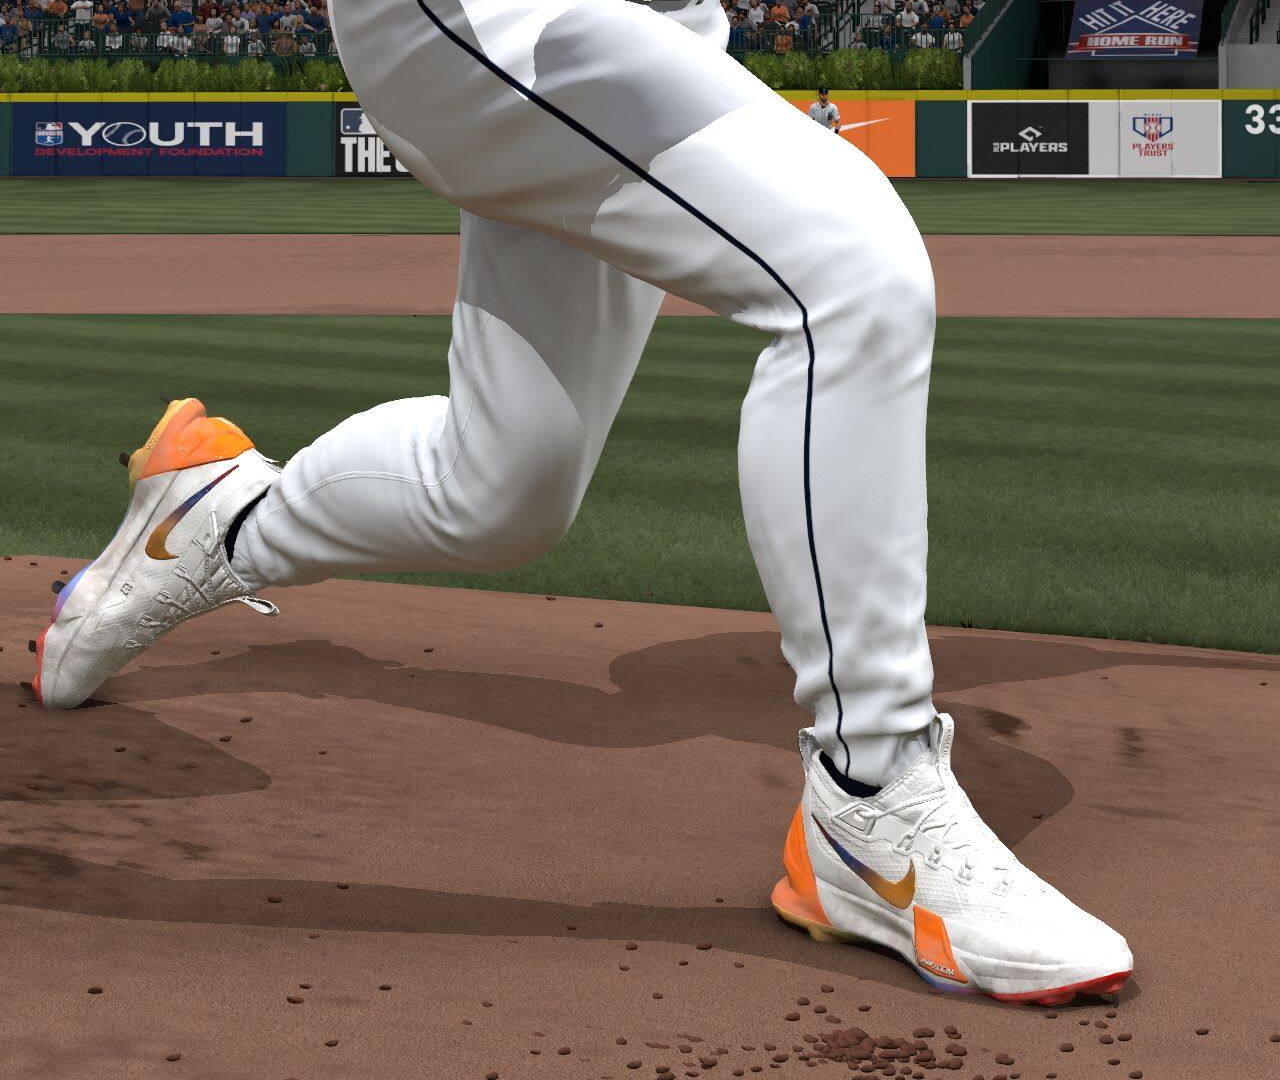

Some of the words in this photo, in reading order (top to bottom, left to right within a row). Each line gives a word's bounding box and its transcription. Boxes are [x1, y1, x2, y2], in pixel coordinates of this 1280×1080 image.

[1079, 8, 1117, 30] HIT
[1108, 1, 1135, 16] IT
[1140, 1, 1196, 30] HERE
[1087, 36, 1140, 46] HOME
[1145, 36, 1183, 46] RUN
[67, 122, 264, 146] YOUTH
[35, 148, 152, 156] DEVELOPMENT
[160, 148, 264, 156] FOUNDATION
[340, 137, 391, 172] THE
[1000, 142, 1068, 152] PLAYERS
